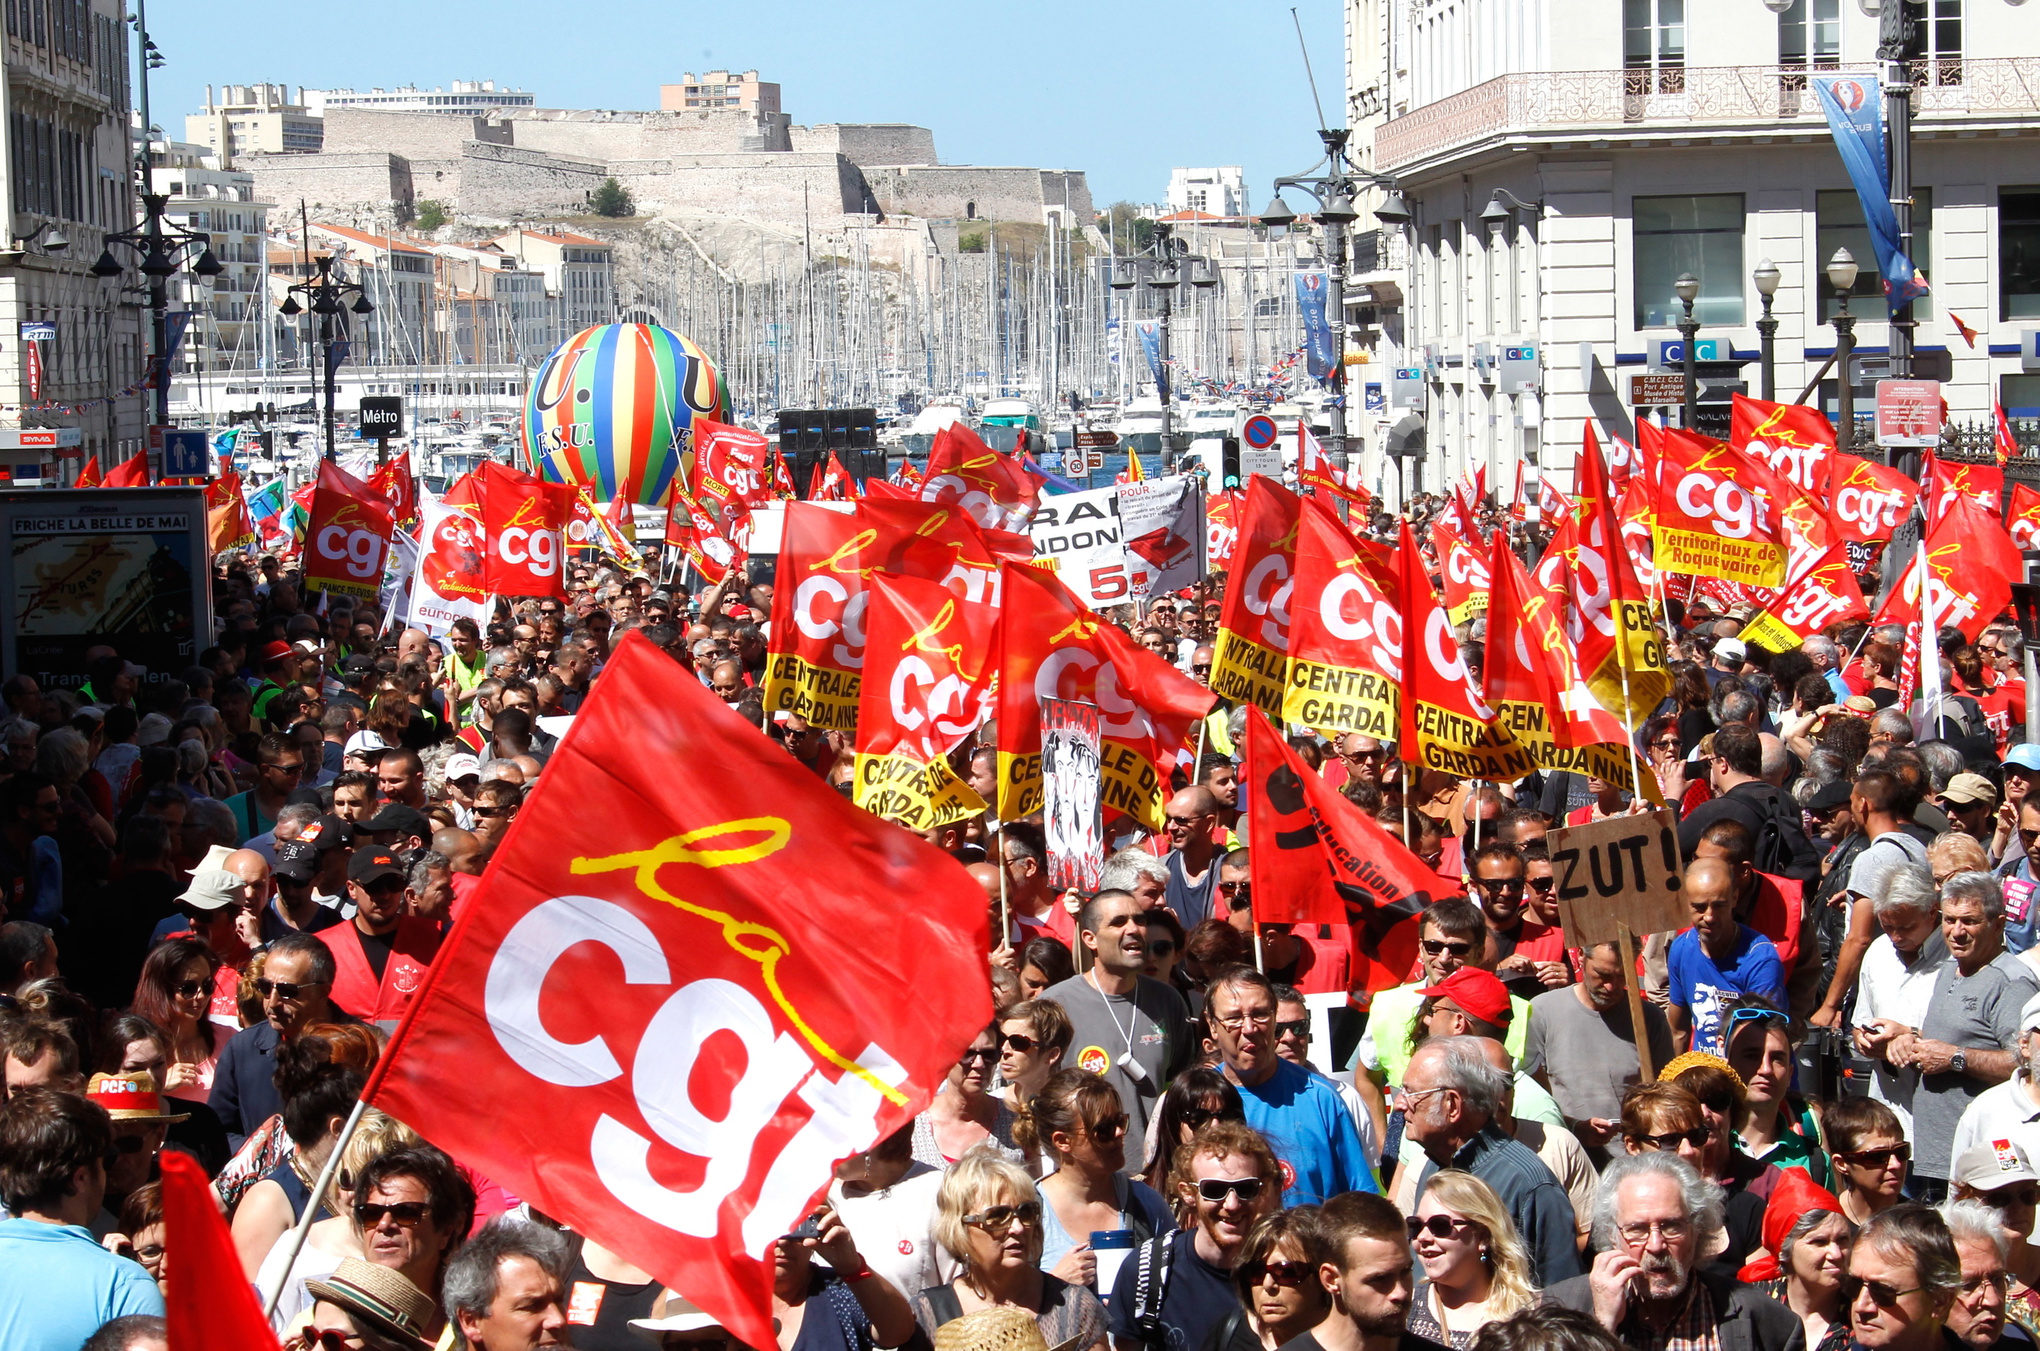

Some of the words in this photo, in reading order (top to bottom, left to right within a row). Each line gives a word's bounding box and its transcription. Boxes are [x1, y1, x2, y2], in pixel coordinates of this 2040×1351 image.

[28, 331, 54, 339] RTM
[1344, 354, 1367, 362] Tabac
[1508, 350, 1532, 359] CIC
[1665, 345, 1711, 361] CC
[28, 348, 37, 393] TABAC
[1397, 369, 1419, 378] CIC
[1643, 383, 1657, 391] Port
[1659, 382, 1684, 390] Antique
[1652, 396, 1678, 404] Marseille
[363, 408, 398, 424] Métro
[1751, 405, 1832, 450] la
[723, 465, 760, 496] cgt
[1302, 473, 1319, 482] Parti
[1685, 443, 1772, 499] la
[1842, 461, 1907, 497] la
[704, 477, 729, 496] MORT
[1119, 486, 1150, 499] POUR
[503, 496, 564, 532] la
[1676, 471, 1772, 539] cgt
[1836, 487, 1904, 537] cgt
[15, 519, 65, 532] FRICHE
[68, 517, 87, 531] LA
[90, 517, 133, 530] BELLE
[136, 516, 154, 529] DE
[158, 515, 187, 529] MAI
[691, 512, 715, 534] cgt
[1206, 521, 1237, 560] gt
[1660, 528, 1752, 559] Territoriaux
[1757, 545, 1777, 562] de
[1672, 547, 1761, 577] Roquevaire
[446, 570, 456, 578] et
[1088, 563, 1129, 601] 5
[1926, 542, 1981, 610] la
[318, 582, 345, 595] FRANCE
[1133, 583, 1150, 596] cgt
[1550, 834, 1649, 901] ZUT
[1658, 827, 1683, 892] !
[569, 815, 910, 1107] la
[1082, 1055, 1106, 1073] cgt
[100, 1080, 127, 1094] PCF
[485, 894, 909, 1261] cgt
